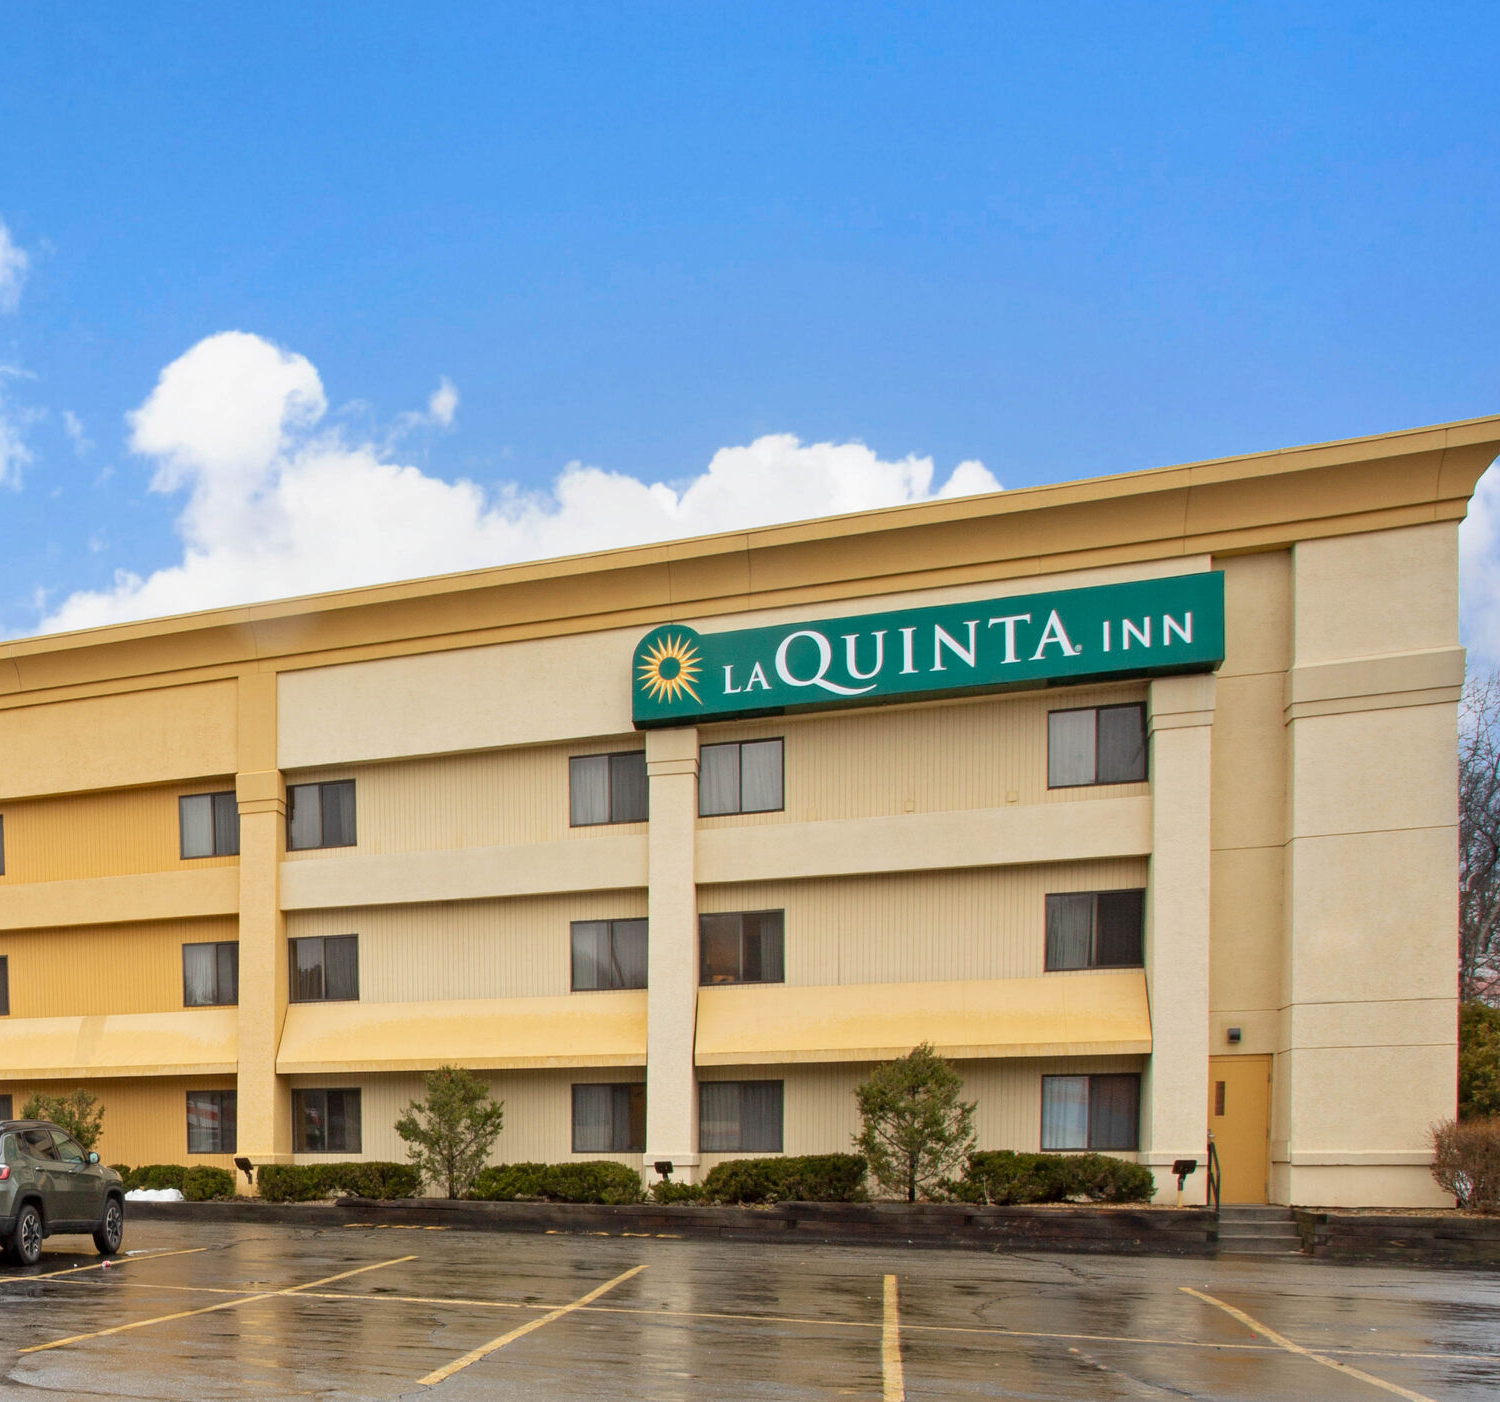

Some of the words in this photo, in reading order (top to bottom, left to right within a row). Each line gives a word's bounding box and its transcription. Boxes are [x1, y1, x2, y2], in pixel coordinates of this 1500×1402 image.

[722, 661, 773, 694] LA
[775, 609, 1081, 696] QUINTA
[1102, 611, 1193, 652] INN
